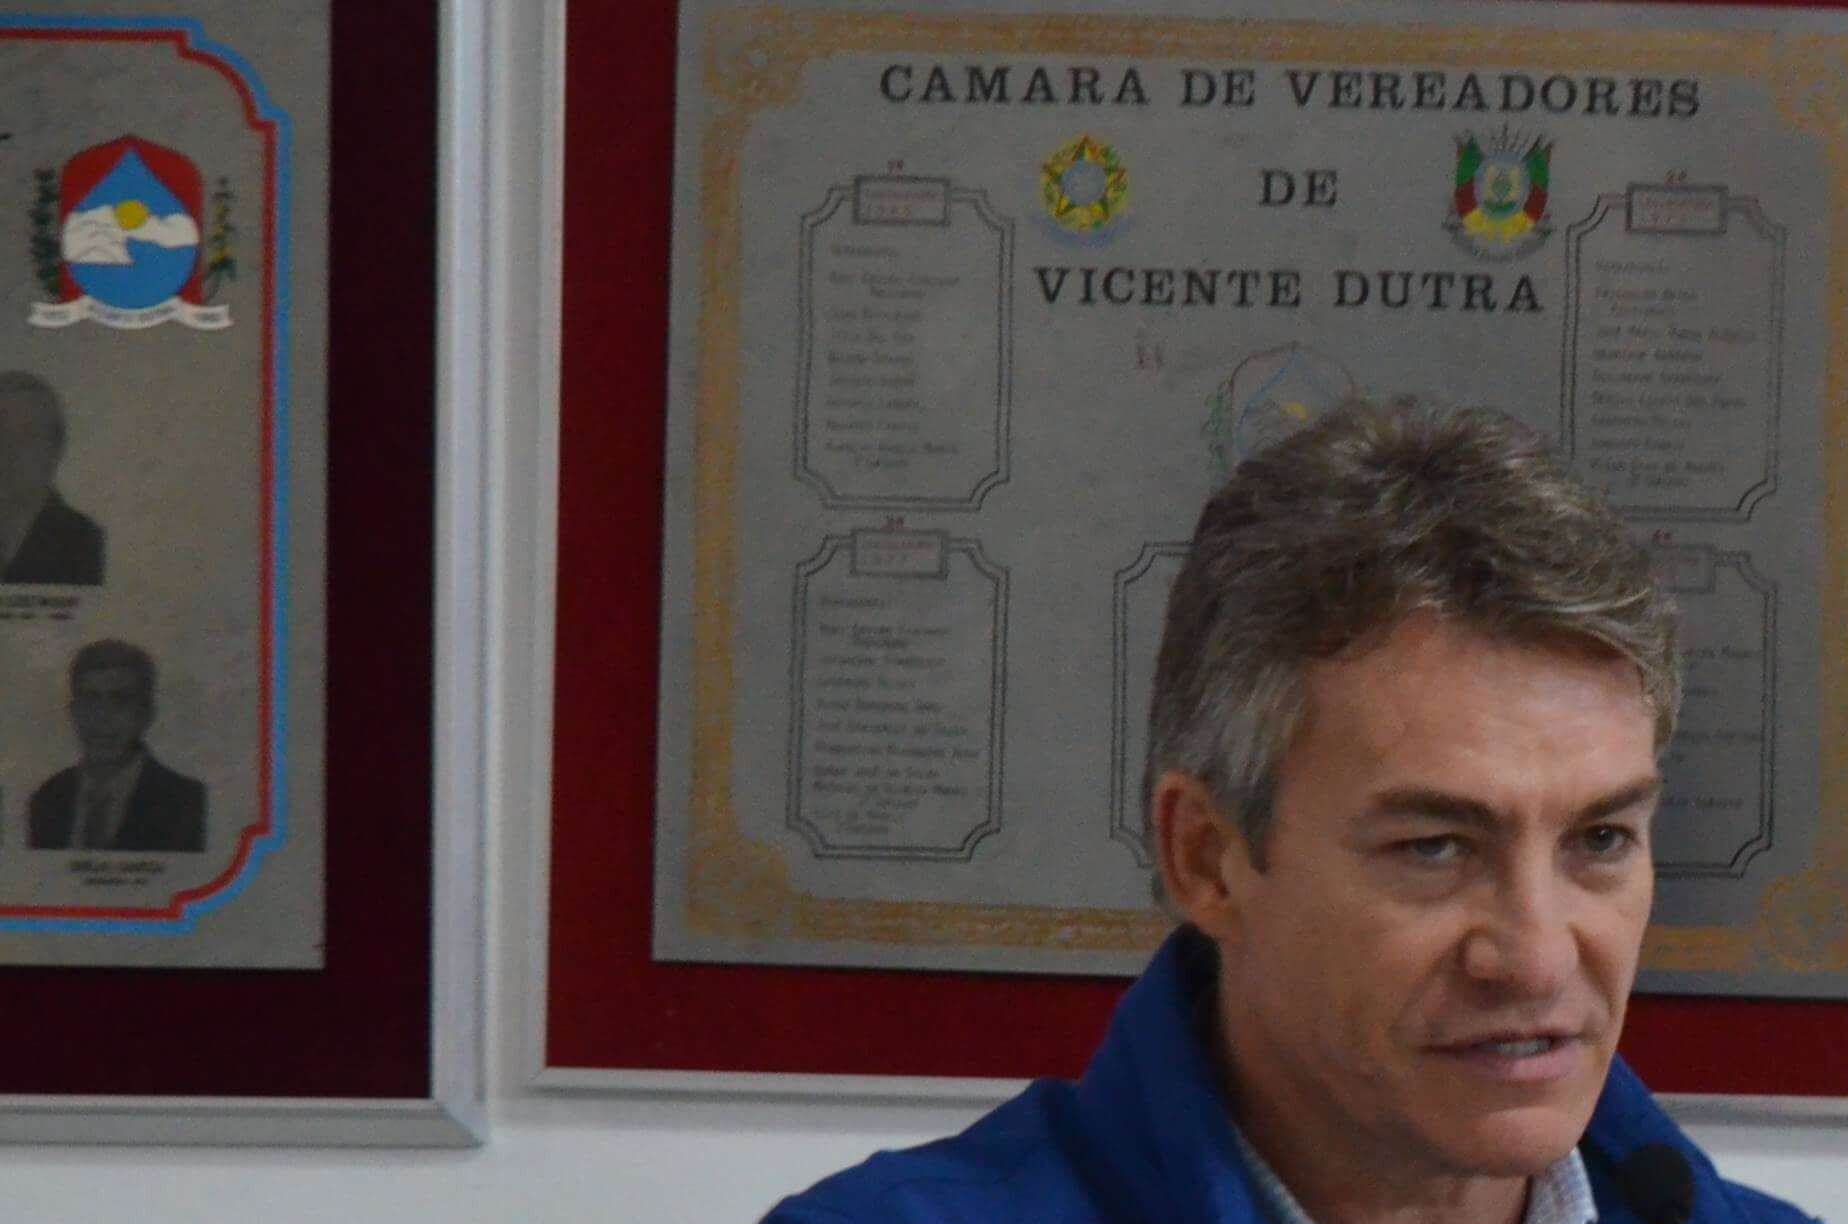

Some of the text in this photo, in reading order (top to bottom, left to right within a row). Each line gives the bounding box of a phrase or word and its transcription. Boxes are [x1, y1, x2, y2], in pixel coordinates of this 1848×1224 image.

[878, 63, 1702, 119] CAMARA DE VEREADORES
[1258, 169, 1339, 209] DE
[1034, 265, 1545, 314] VICENTE DUTRA
